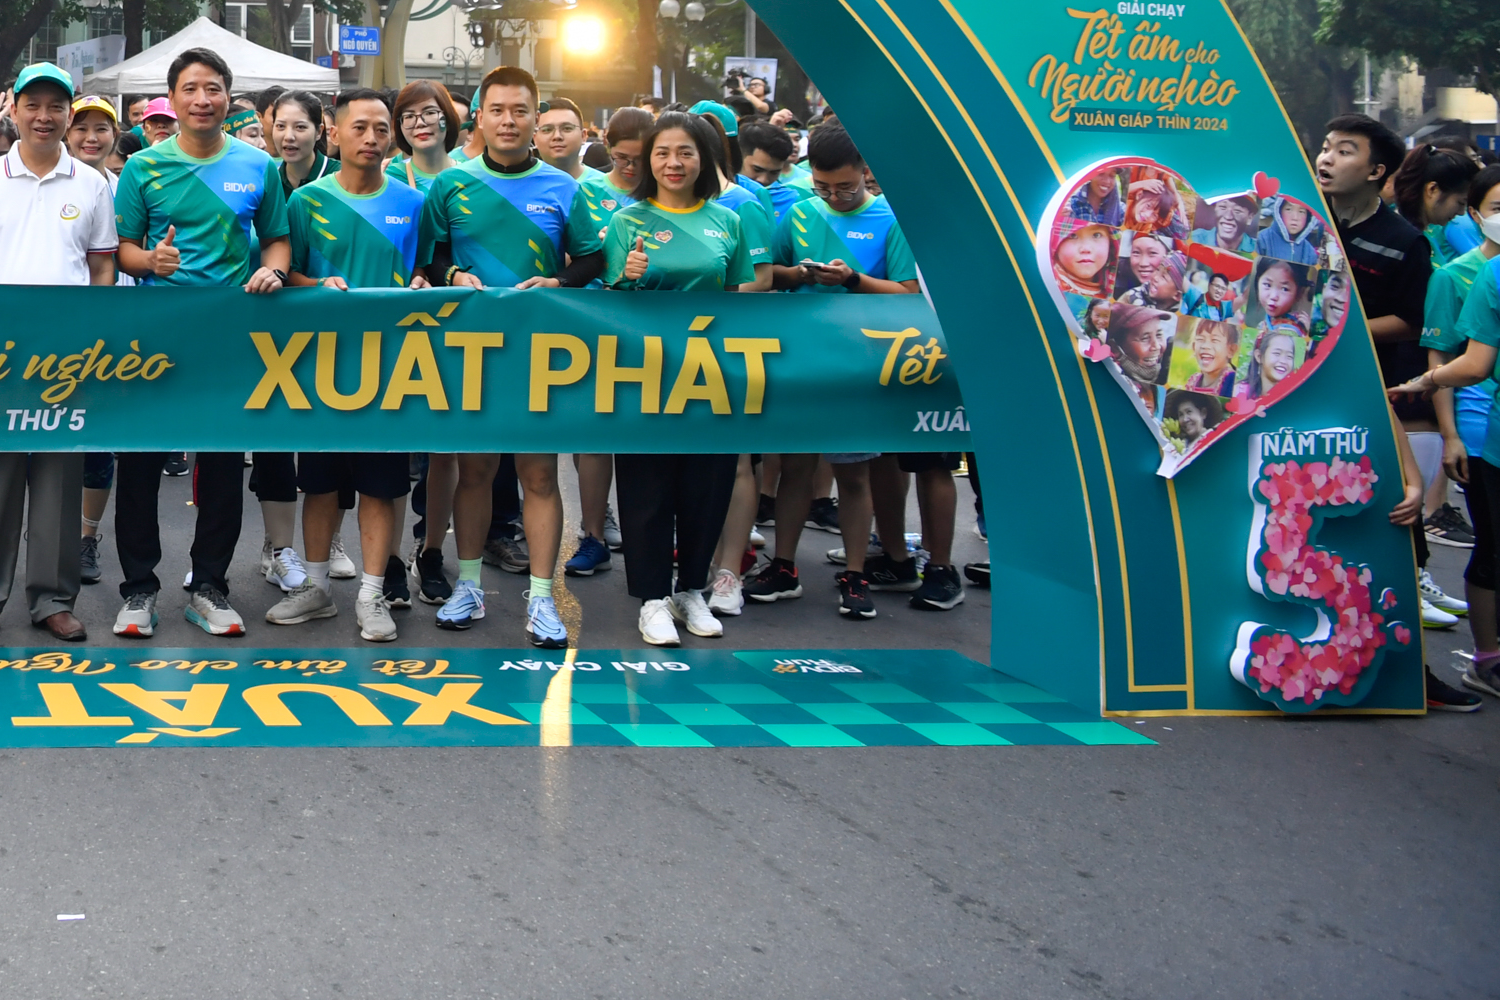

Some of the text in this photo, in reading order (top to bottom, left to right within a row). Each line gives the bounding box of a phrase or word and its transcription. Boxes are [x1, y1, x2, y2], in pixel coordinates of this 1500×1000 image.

[1117, 0, 1186, 20] GIẢI CHẠY
[1066, 7, 1221, 66] Tết ấm cho
[1028, 53, 1242, 124] Người nghèo
[1074, 110, 1229, 132] XUÂN GIÁP THÌN 2024
[223, 182, 248, 193] BIDV
[526, 203, 547, 214] BIDV
[385, 215, 404, 225] BIDV
[703, 228, 723, 239] BIDV
[846, 230, 867, 240] BIDV
[243, 301, 782, 415] XUẤT PHÁT
[860, 327, 947, 387] Tết
[22, 337, 175, 404] nghèo
[5, 405, 68, 432] THỨ
[68, 408, 86, 432] 5
[1263, 427, 1369, 457] NĂM THỨ
[131, 659, 239, 675] cho
[253, 659, 348, 677] ấm
[371, 659, 483, 680] Tết
[498, 658, 691, 675] GIẢI CHẠY
[10, 682, 532, 744] XUẤT
